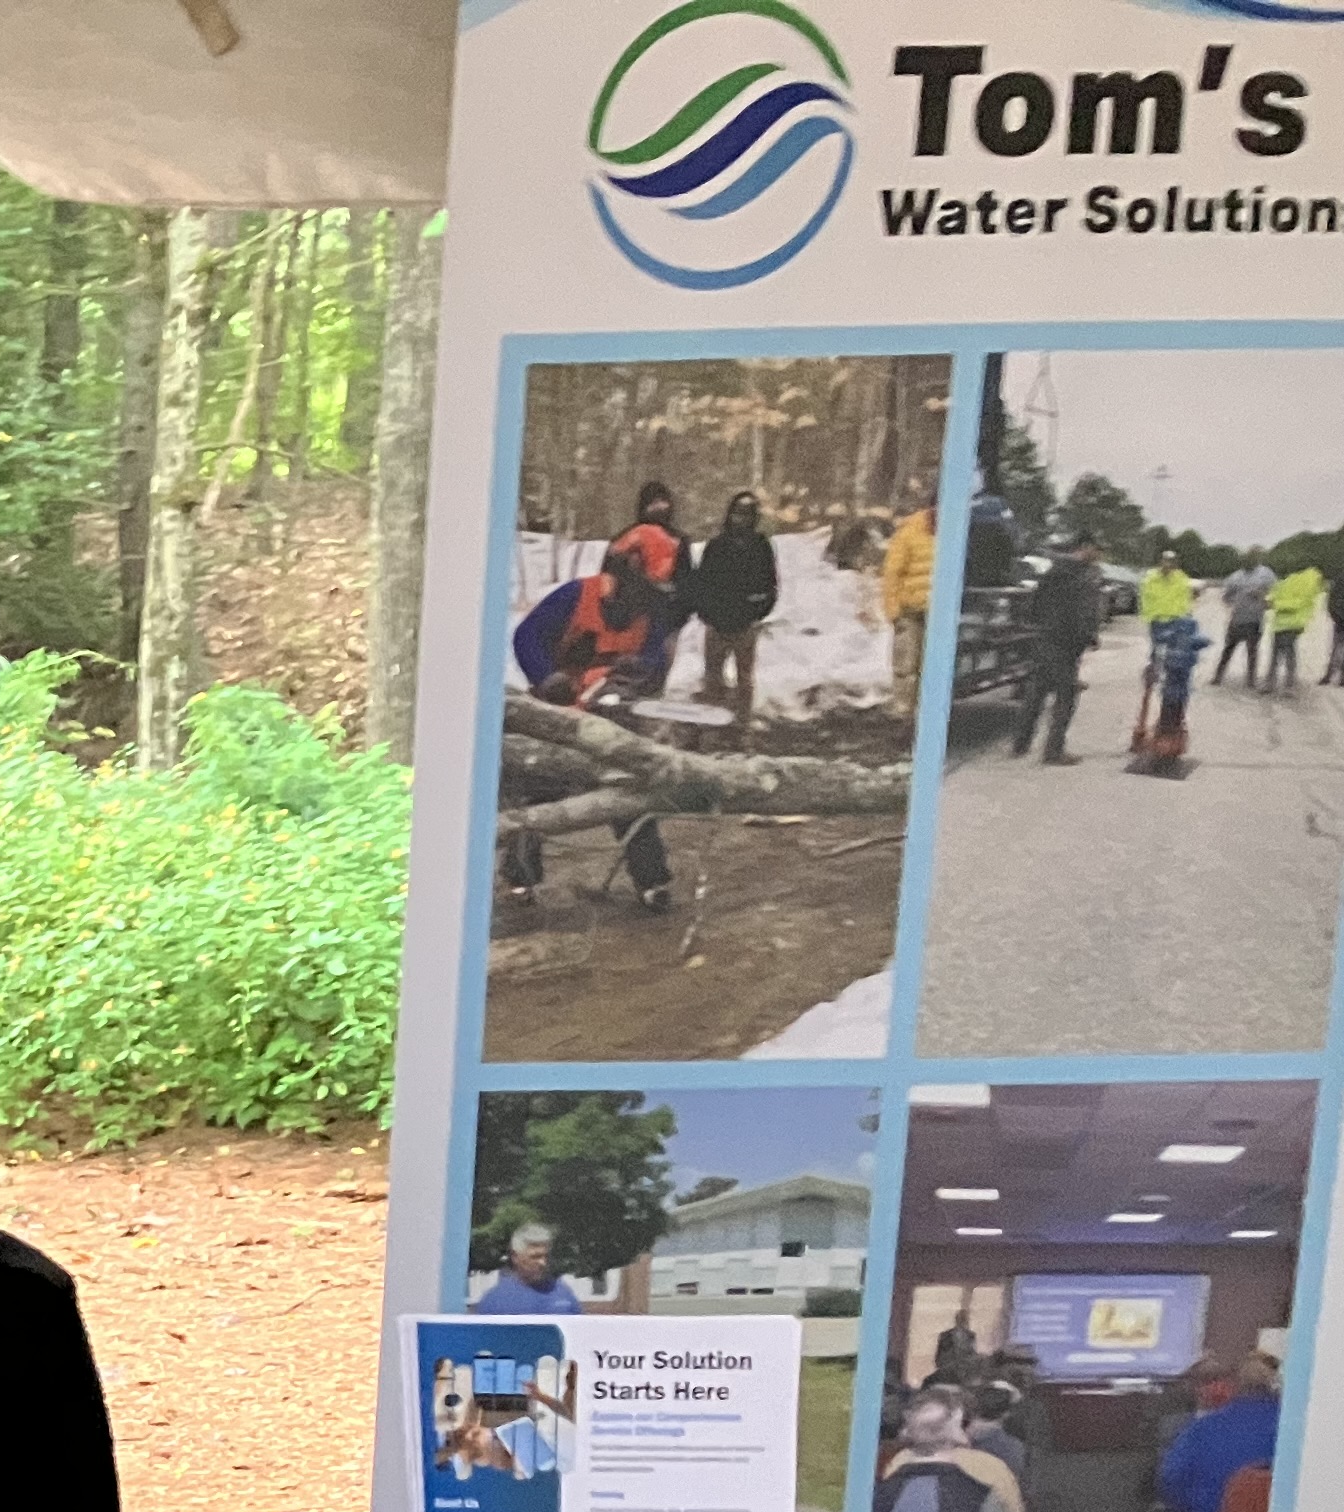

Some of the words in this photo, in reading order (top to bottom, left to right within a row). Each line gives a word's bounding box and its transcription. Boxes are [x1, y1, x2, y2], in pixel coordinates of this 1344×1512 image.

[893, 44, 1310, 158] Tom's
[878, 188, 1069, 236] Water
[1084, 185, 1344, 235] Solution
[593, 1349, 646, 1370] Your
[653, 1350, 753, 1371] Solution
[593, 1381, 666, 1401] Starts
[673, 1381, 730, 1401] Here
